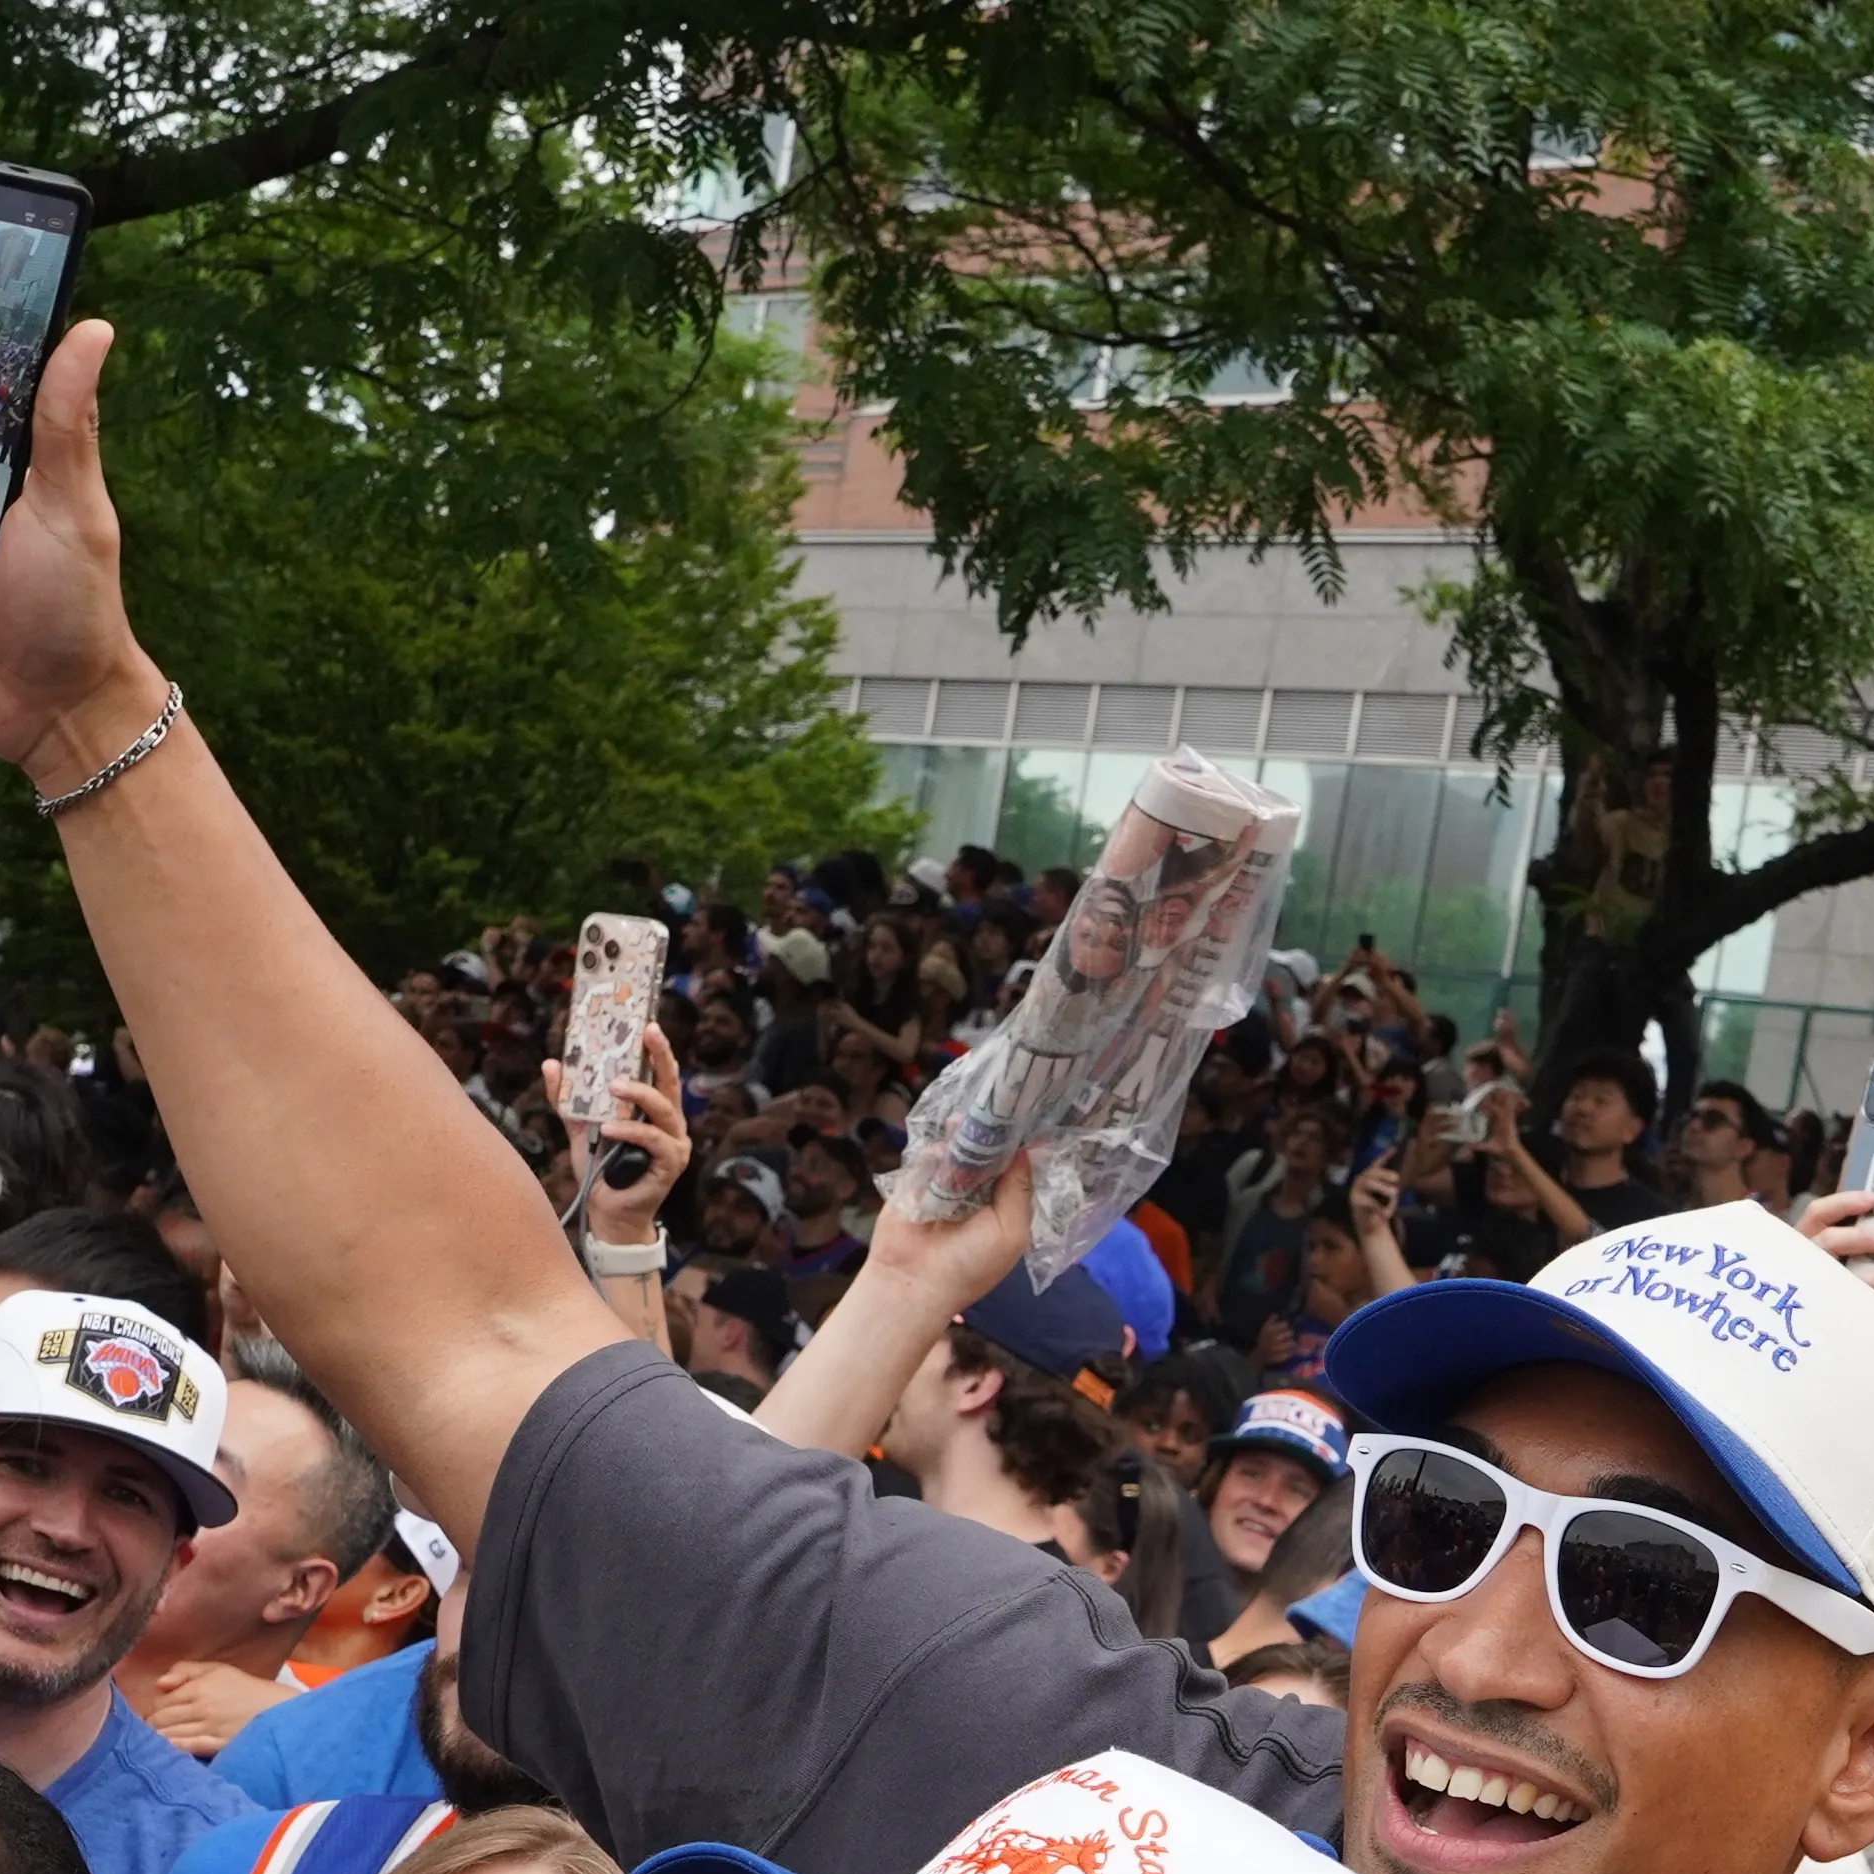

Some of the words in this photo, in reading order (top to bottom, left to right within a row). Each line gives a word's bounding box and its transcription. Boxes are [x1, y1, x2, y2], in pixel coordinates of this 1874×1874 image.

[1602, 1234, 1705, 1266] New
[1704, 1243, 1812, 1348] York
[44, 1331, 64, 1345] 20
[82, 1313, 111, 1332] NBA
[113, 1317, 185, 1364] CHAMPIONS
[1564, 1276, 1613, 1297] or
[1610, 1264, 1798, 1373] Nowhere
[40, 1344, 62, 1358] 25
